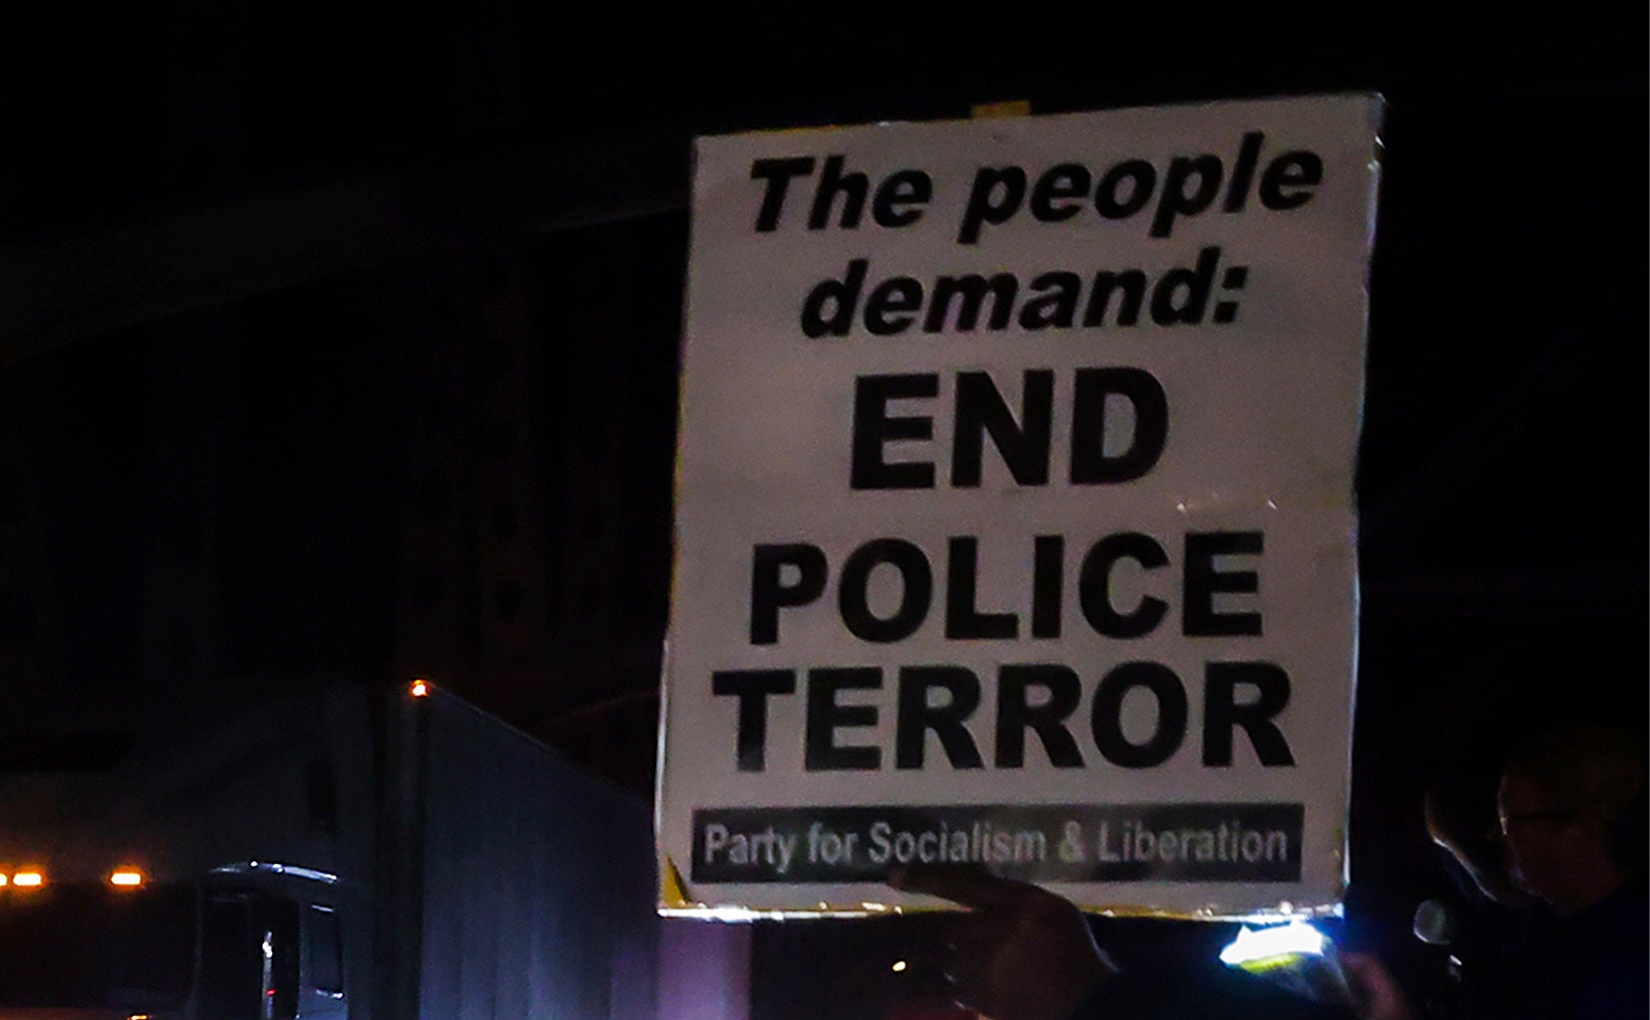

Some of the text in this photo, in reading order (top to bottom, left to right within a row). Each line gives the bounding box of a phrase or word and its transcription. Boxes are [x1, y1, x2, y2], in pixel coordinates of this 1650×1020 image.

[750, 132, 1324, 245] The people
[800, 247, 1249, 339] demand:
[850, 366, 1170, 490] END
[748, 531, 1266, 645] POLICE
[711, 661, 1295, 773] TERROR
[702, 821, 1288, 874] Party for Socialism & Liberation
